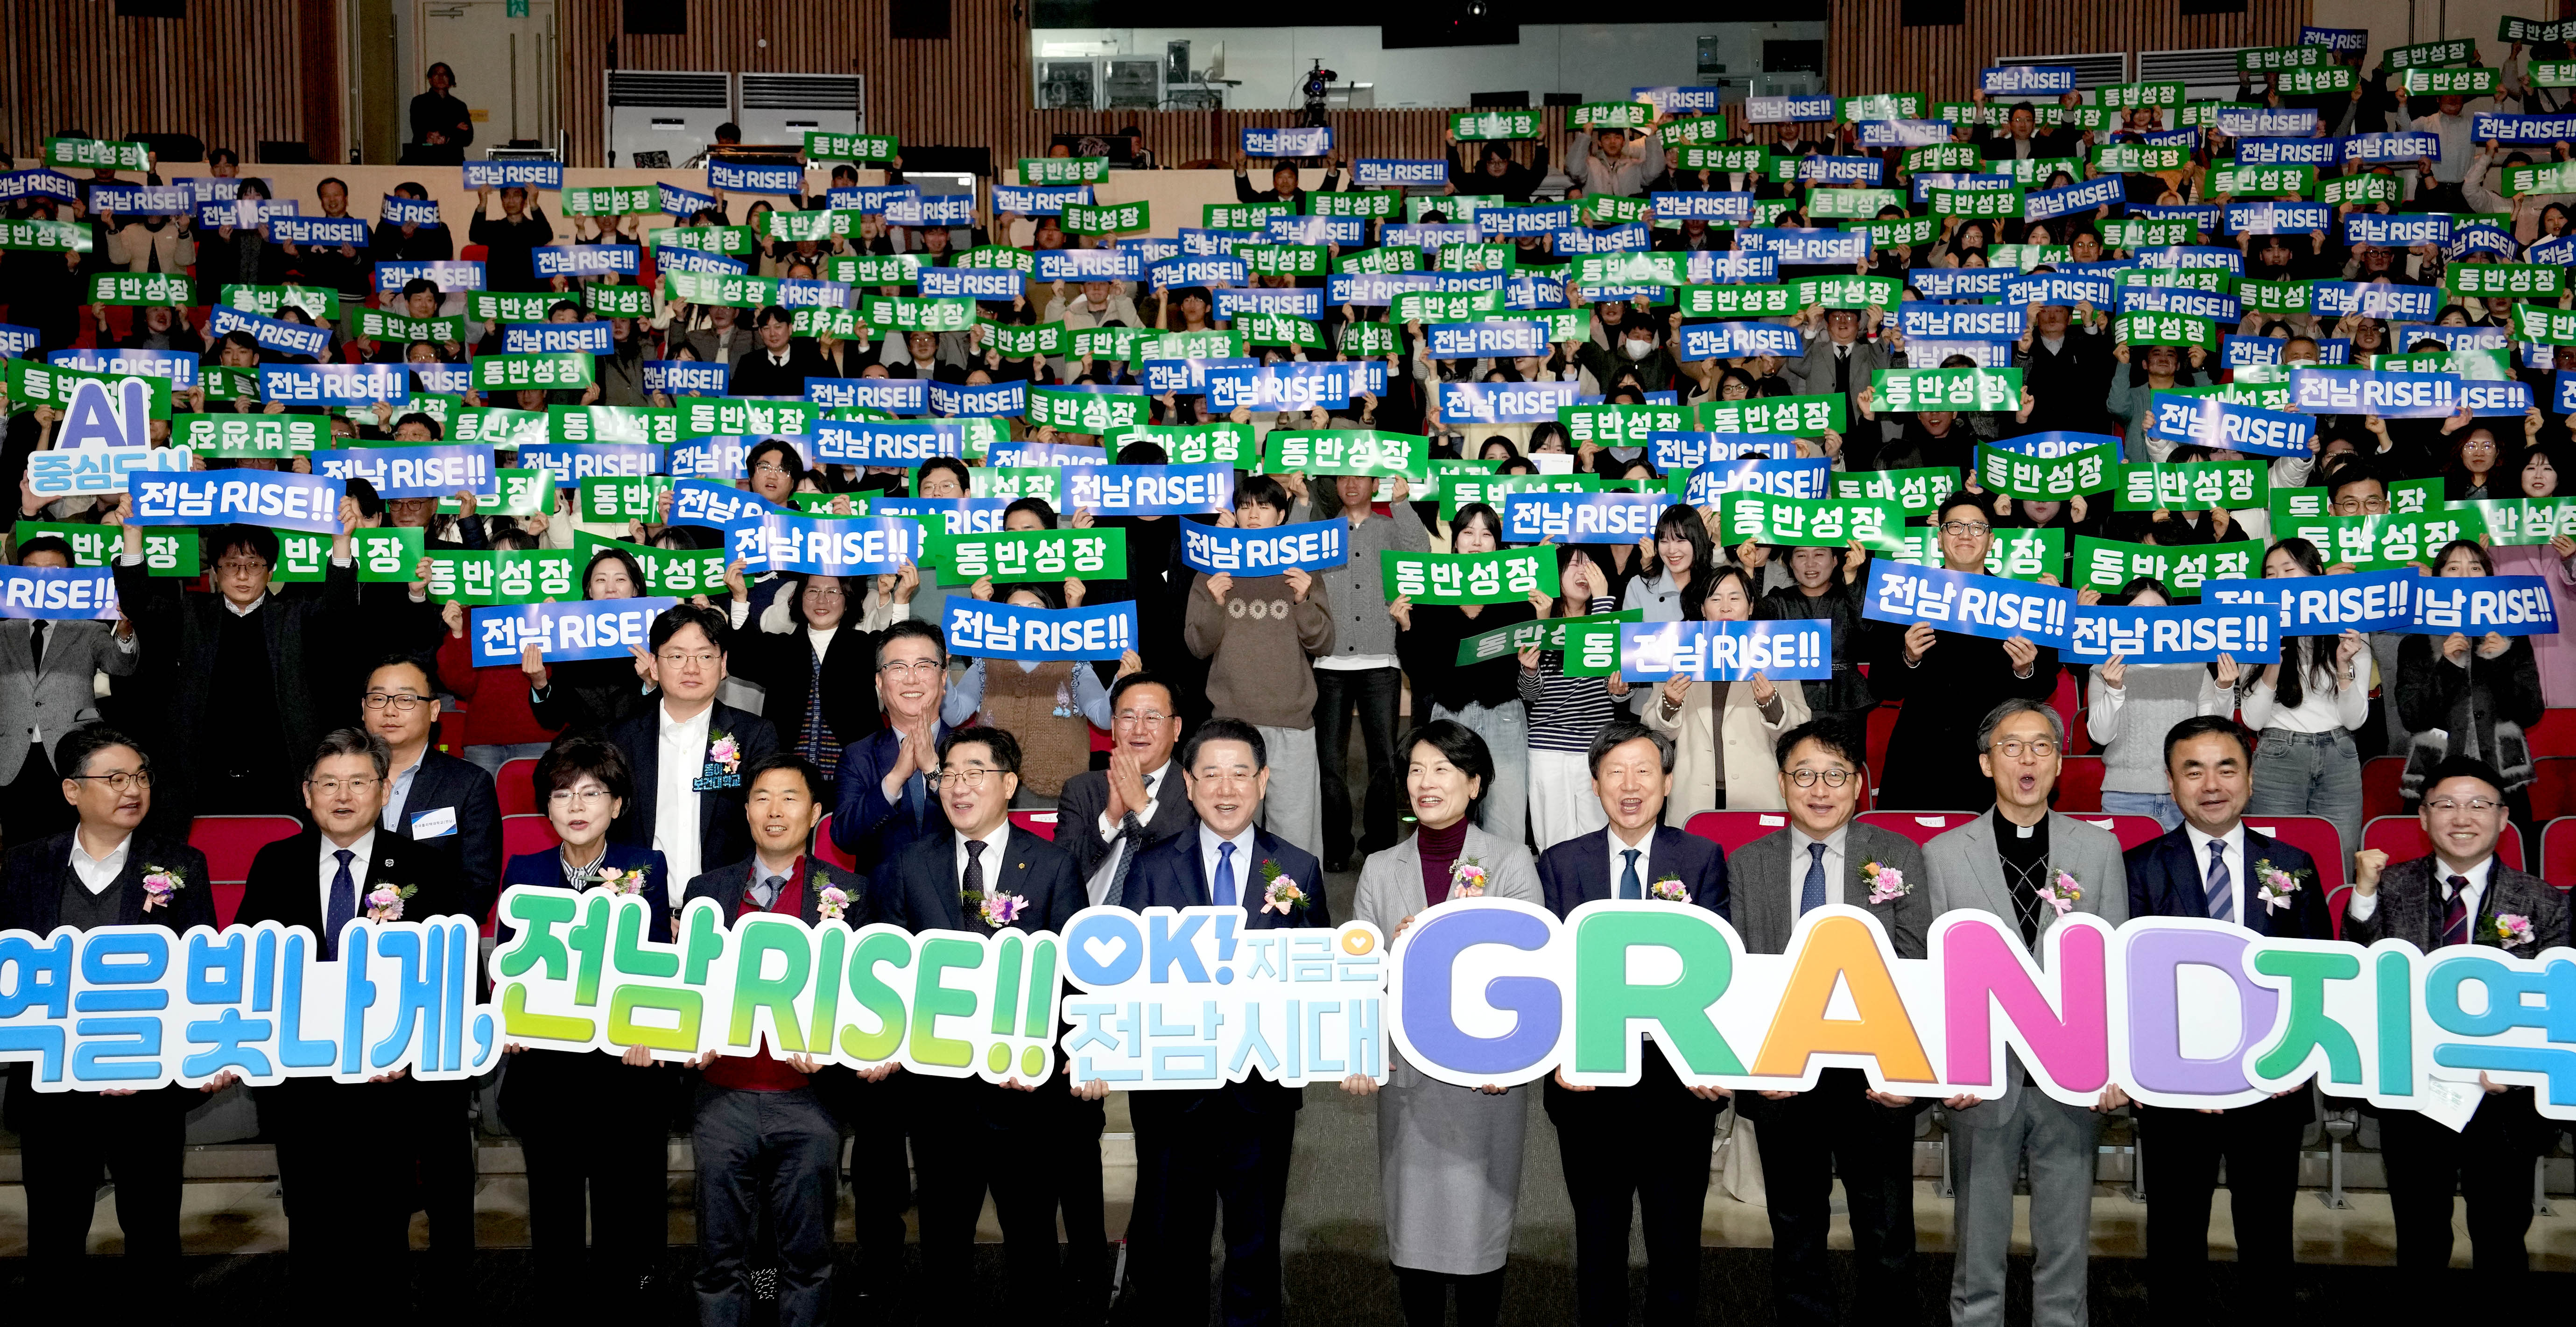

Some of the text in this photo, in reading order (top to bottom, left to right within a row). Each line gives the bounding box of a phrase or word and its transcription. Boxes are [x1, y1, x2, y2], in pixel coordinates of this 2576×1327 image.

[2337, 35, 2365, 49] RISE!!
[2393, 43, 2465, 67] 동반성장
[2246, 49, 2317, 68] 동반성장
[1984, 71, 2070, 91] 전남 RISE!!
[2279, 69, 2349, 92] 동반성장
[2412, 72, 2490, 90] 동반성장
[1752, 99, 1830, 119] 전남 RISE!!
[2105, 86, 2175, 107] 동반성장
[1864, 124, 1898, 143] 전남
[2221, 112, 2313, 133] 전남 RISE!!
[2479, 119, 2576, 138] 전남 RISE!!
[56, 141, 140, 167] 동반성장
[814, 137, 888, 157] 동반성장
[1246, 134, 1279, 152] 전남
[2242, 143, 2333, 162] 전남 RISE!!
[2345, 138, 2436, 160] 전남 RISE!!
[1688, 149, 1760, 170] 동반성장
[1829, 162, 1878, 180] RISE!!
[2099, 148, 2179, 169] 동반성장
[467, 166, 557, 186] 전남 RISE!!
[712, 166, 797, 189] 전남 RISE!!
[1028, 161, 1100, 183] 동반성장
[1359, 164, 1443, 181] 전남 RISE!!
[2215, 170, 2302, 192] 동반성장
[28, 175, 76, 198] RISE!!
[2028, 180, 2119, 213] 전남 RISE!!
[2325, 176, 2396, 202] 동반성장
[94, 189, 189, 211] 전남 RISE!!
[570, 189, 650, 212] 동반성장
[884, 199, 970, 222] 전남 RISE!!
[1316, 195, 1390, 215] 동반성장
[1656, 197, 1748, 217] 전남 RISE!!
[1936, 193, 2014, 214] 동반성장
[274, 221, 362, 241] 전남 RISE!!
[768, 212, 851, 237] 동반성장
[1068, 207, 1139, 231] 동반성장
[1480, 211, 1567, 233] 전남 RISE!!
[2230, 207, 2327, 230] 전남 RISE!!
[2349, 219, 2449, 243] 전남 RISE!!
[1559, 227, 1645, 253] 전남 RISE!!
[1767, 234, 1866, 262] 전남 RISE!!
[538, 249, 633, 273] 전남 RISE!!
[1041, 254, 1138, 276] 전남 RISE!!
[921, 273, 1020, 296] 전남 RISE!!
[1152, 262, 1243, 287] 전남 RISE!!
[2458, 269, 2555, 291] 동반성장
[97, 277, 188, 302] 동반성장
[674, 275, 766, 304] 동반성장
[1692, 290, 1788, 311] 동반성장
[2008, 279, 2109, 306] 전남 RISE!!
[2318, 287, 2431, 315] 전남 RISE!!
[873, 301, 965, 327] 동반성장
[1905, 311, 2020, 335] 전남 RISE!!
[363, 314, 452, 341] 동반성장
[507, 328, 607, 353] 전남 RISE!!
[1435, 326, 1542, 353] 전남 RISE!!
[1141, 335, 1231, 361] 동반성장
[1687, 328, 1796, 355] 전남 RISE!!
[484, 358, 583, 384] 동반성장
[644, 367, 723, 390] 전남 RISE!!
[267, 371, 401, 401] 전남 RISE!!
[812, 385, 921, 408] 전남 RISE!!
[930, 382, 1024, 413] 전남 RISE!!
[1212, 373, 1342, 406] 전남 RISE!!
[1886, 374, 2008, 405] 동반성장
[2298, 377, 2452, 408] 전남 RISE!!
[61, 382, 145, 448] AI
[1032, 392, 1137, 427] 동반성장
[1447, 388, 1573, 418] 전남 RISE!!
[691, 403, 804, 436] 동반성장
[1715, 402, 1831, 436] 동반성장
[2219, 413, 2305, 450] RISE!!
[187, 421, 316, 452] 동반성장
[1281, 434, 1411, 469] 동반성장
[1987, 454, 2102, 493] 동반성장
[2127, 467, 2254, 503] 동반성장
[139, 480, 335, 523] 전남 RISE!!
[1071, 473, 1224, 508] 전남 RISE!!
[1513, 502, 1574, 536] 전남
[1734, 500, 1887, 541] 동반성장
[733, 525, 909, 565] 전남 RISE!!
[956, 537, 1106, 575] 동반성장
[1187, 529, 1338, 569] 전남 RISE!!
[426, 558, 572, 595] 동반성장
[1396, 557, 1540, 598] 동반성장
[5, 578, 115, 610] RISE!!
[1879, 573, 2066, 636] 전남 RISE!!
[2471, 587, 2551, 624] RISE!!
[482, 613, 554, 657] 전남
[951, 609, 1128, 651] 전남 RISE!!
[2072, 615, 2267, 656] 전남 RISE!!
[1633, 630, 1819, 673] 전남 RISE!!
[1067, 915, 1380, 986] OK! 지금은
[500, 894, 1057, 1077] 전남 RISE!!
[0, 924, 494, 1083] 역을 빛나게,
[1402, 908, 2576, 1106] GRAND 지역
